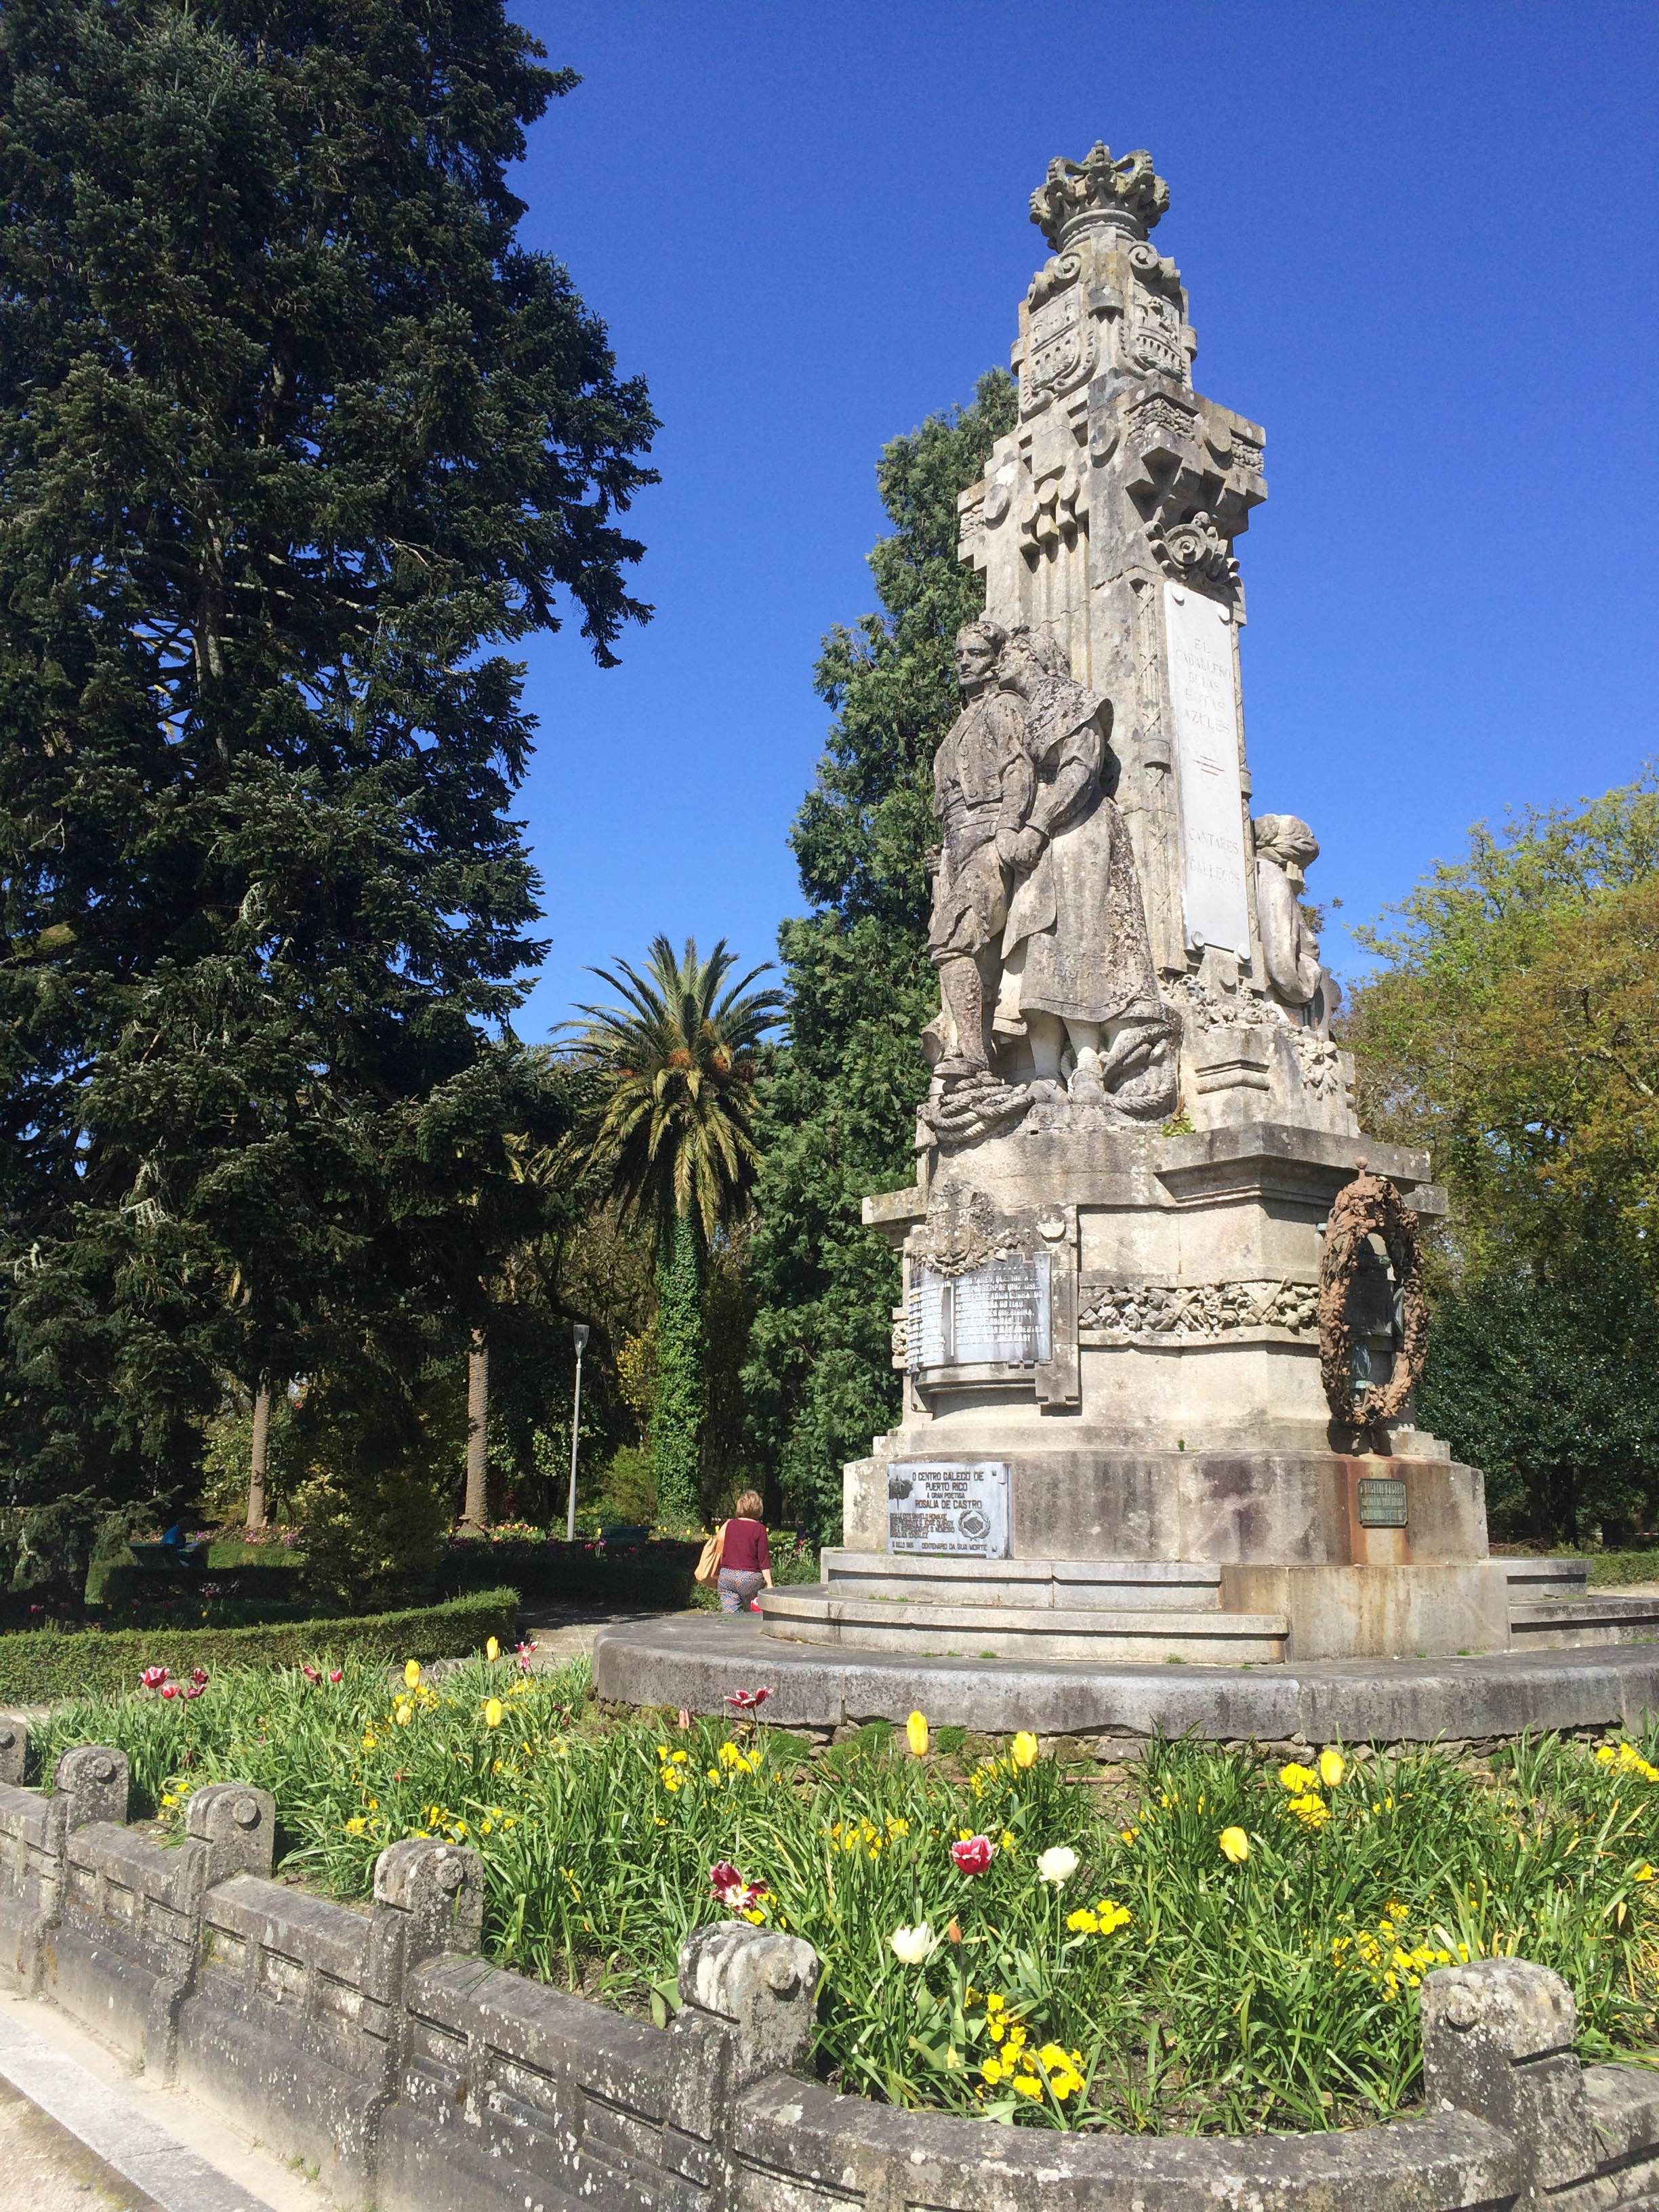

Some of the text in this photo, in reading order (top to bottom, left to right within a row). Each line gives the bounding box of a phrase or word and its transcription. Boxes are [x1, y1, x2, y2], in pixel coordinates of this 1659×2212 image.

[1194, 638, 1210, 654] EL
[912, 1471, 985, 1481] O CENTRO GALEGO DE
[926, 1482, 968, 1491] PUERTO RICO
[916, 1499, 983, 1509] ROSALIA DE CASTRO
